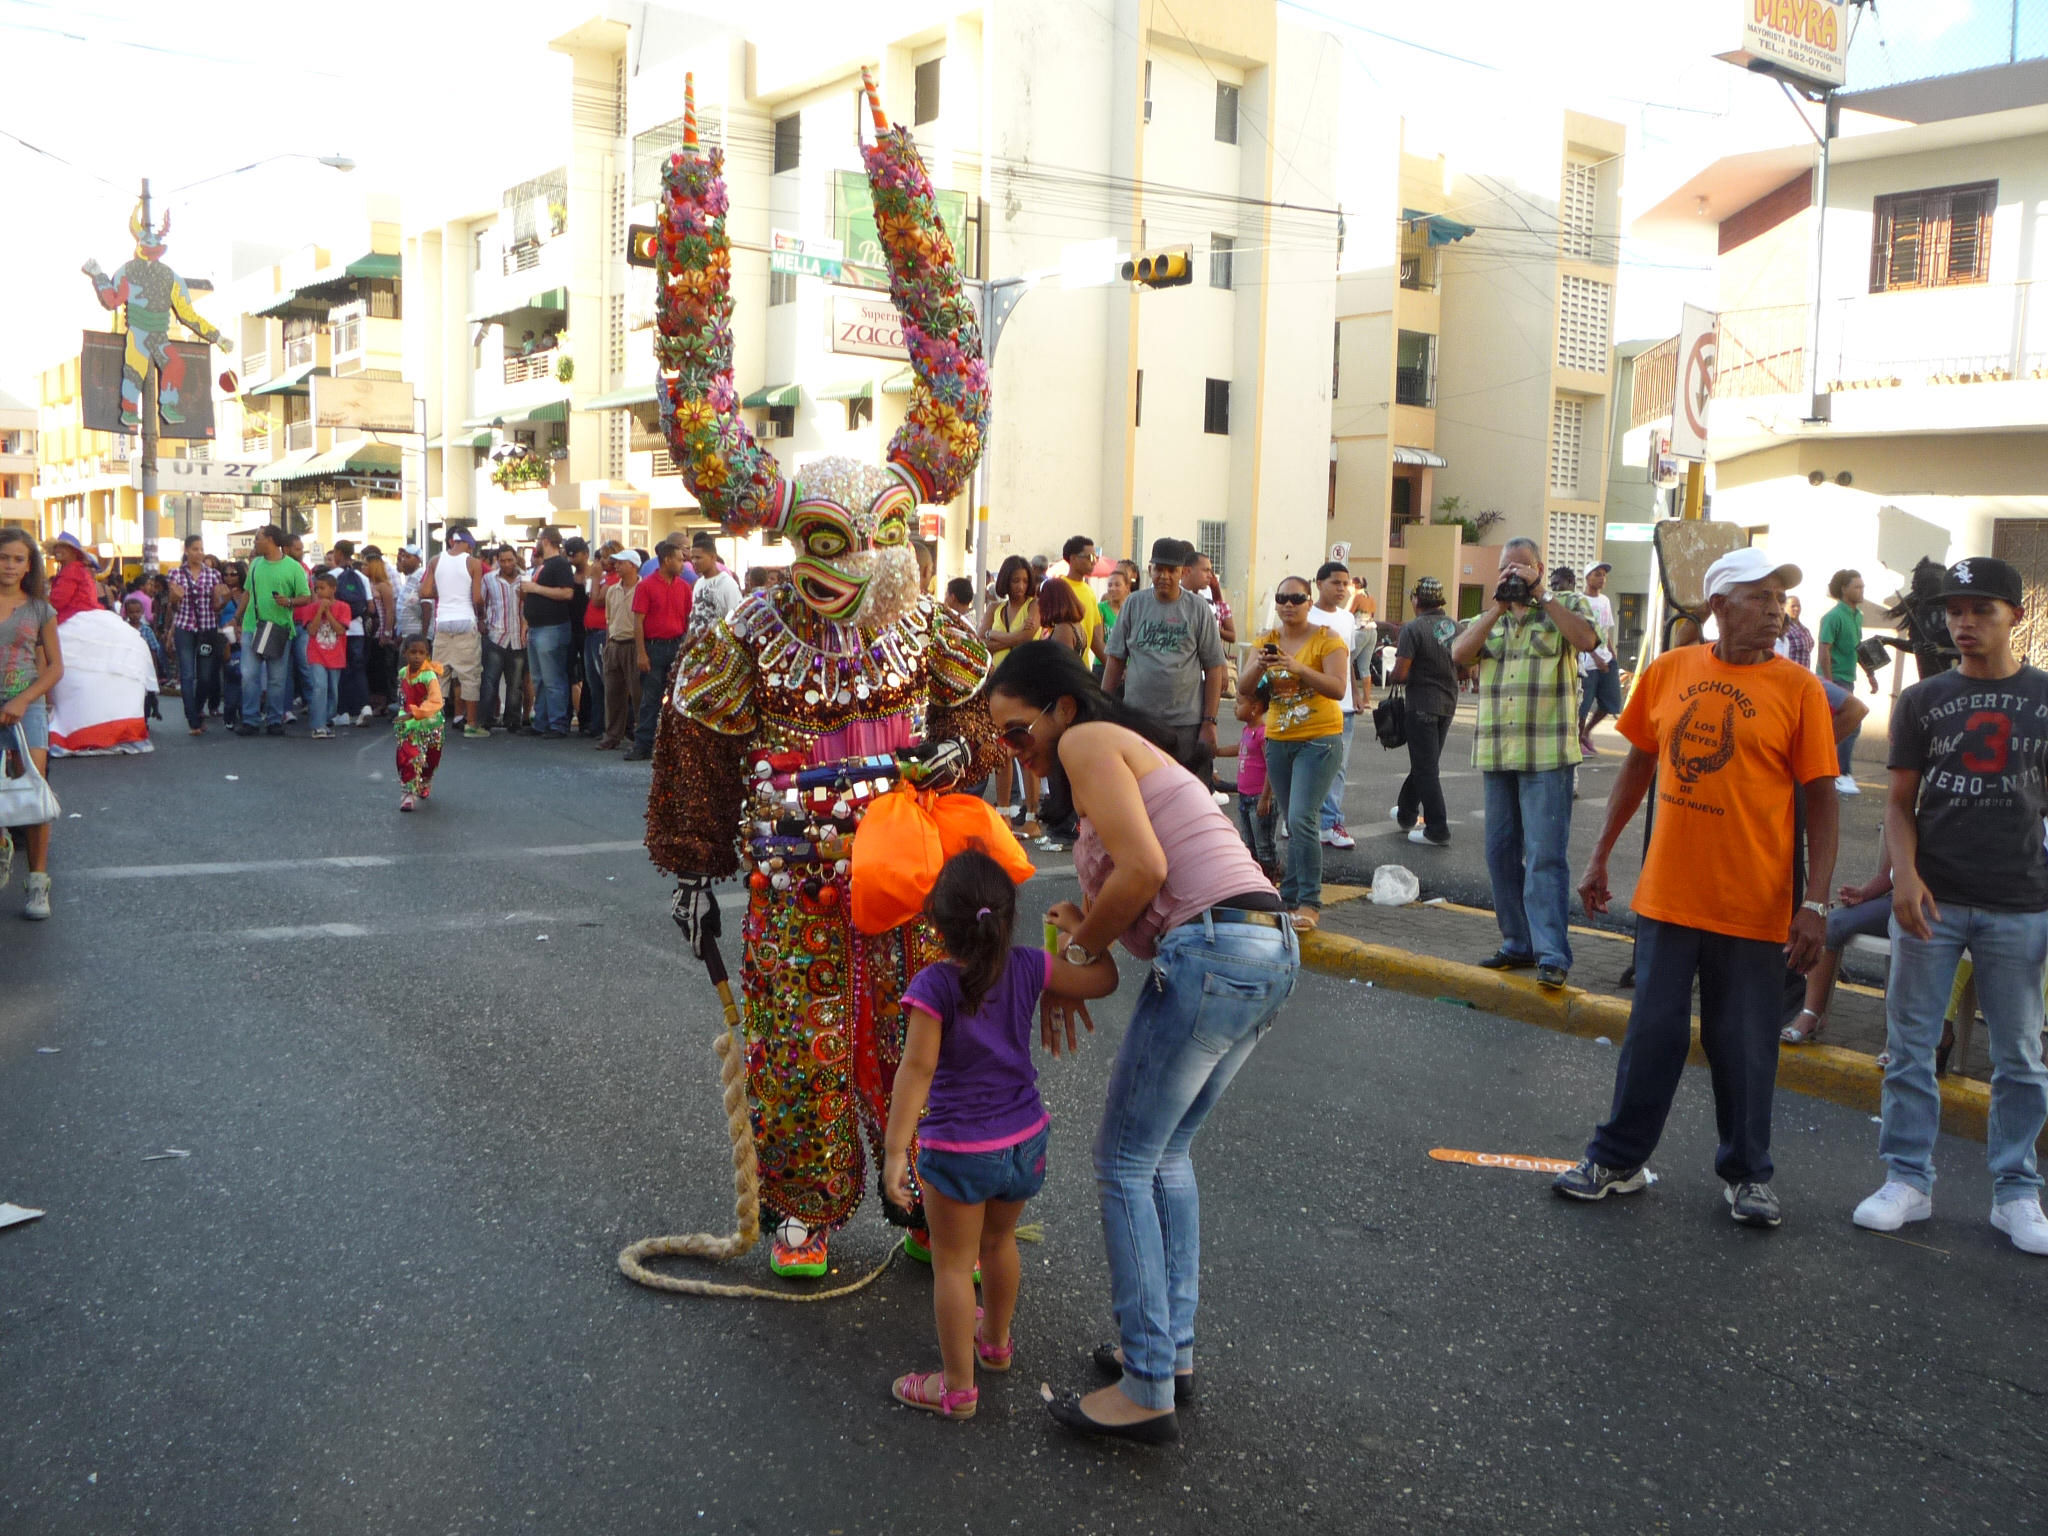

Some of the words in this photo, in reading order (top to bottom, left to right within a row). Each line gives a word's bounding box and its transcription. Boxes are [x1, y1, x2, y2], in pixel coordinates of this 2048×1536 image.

[1747, 23, 1786, 44] MAYORISTA
[1754, 0, 1838, 52] MAYRA
[772, 252, 821, 276] MELLA
[173, 462, 213, 476] UT
[224, 464, 258, 477] 27
[241, 538, 252, 547] UT
[1679, 680, 1756, 719] LECHONES
[1920, 693, 2029, 730] PROPERTY
[1694, 721, 1716, 733] LOS
[1684, 733, 1718, 748] REYES
[1962, 711, 2012, 773] 3
[1680, 785, 1693, 794] DE
[1688, 800, 1725, 816] NUEVO
